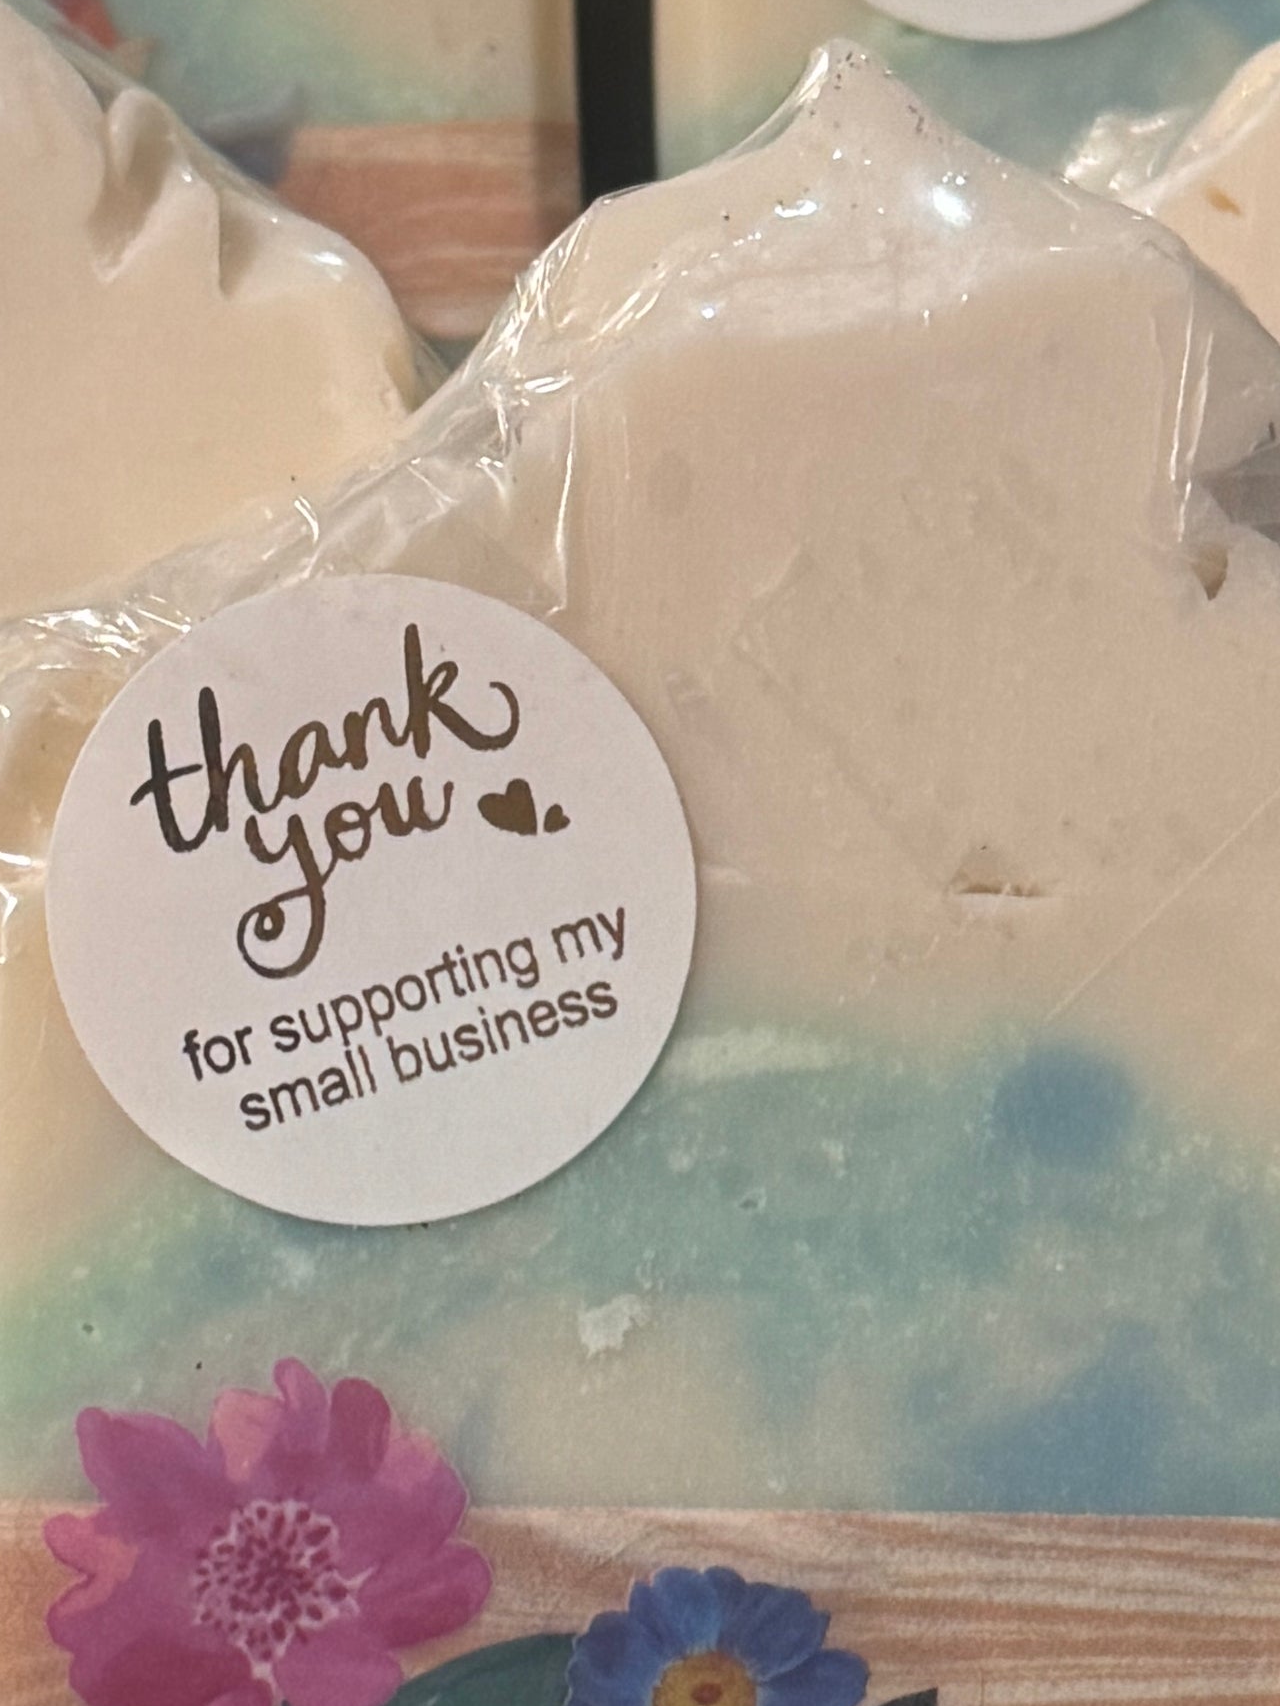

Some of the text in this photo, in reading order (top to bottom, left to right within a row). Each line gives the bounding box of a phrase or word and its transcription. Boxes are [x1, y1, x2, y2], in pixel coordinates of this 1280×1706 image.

[130, 623, 519, 853] thank
[236, 776, 454, 979] you
[184, 906, 626, 1080] for supporting my
[239, 980, 619, 1131] small business
